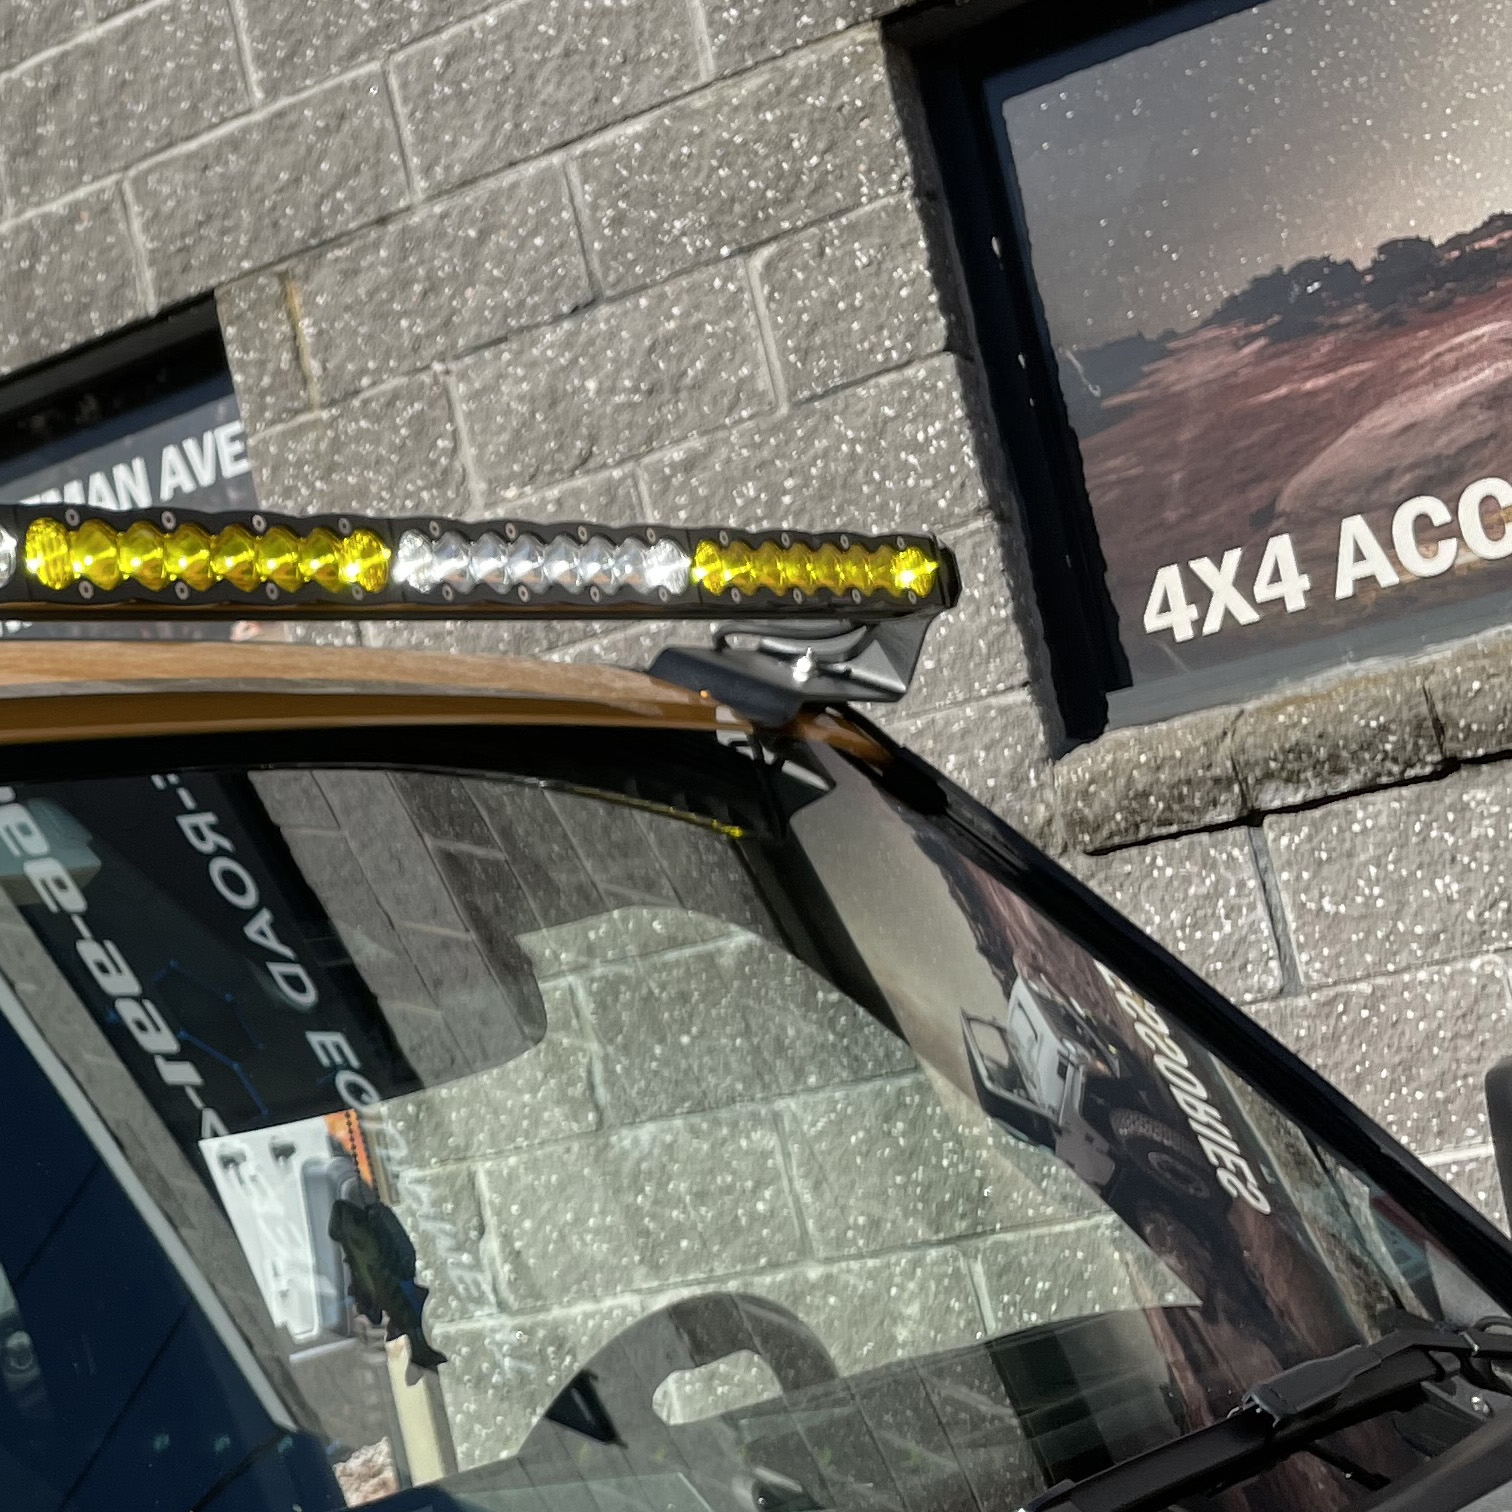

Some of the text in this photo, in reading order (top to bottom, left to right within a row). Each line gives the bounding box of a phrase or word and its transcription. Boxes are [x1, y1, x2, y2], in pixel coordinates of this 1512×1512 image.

[19, 419, 250, 512] MAN AVE
[1143, 476, 1512, 643] 4X4 ACC
